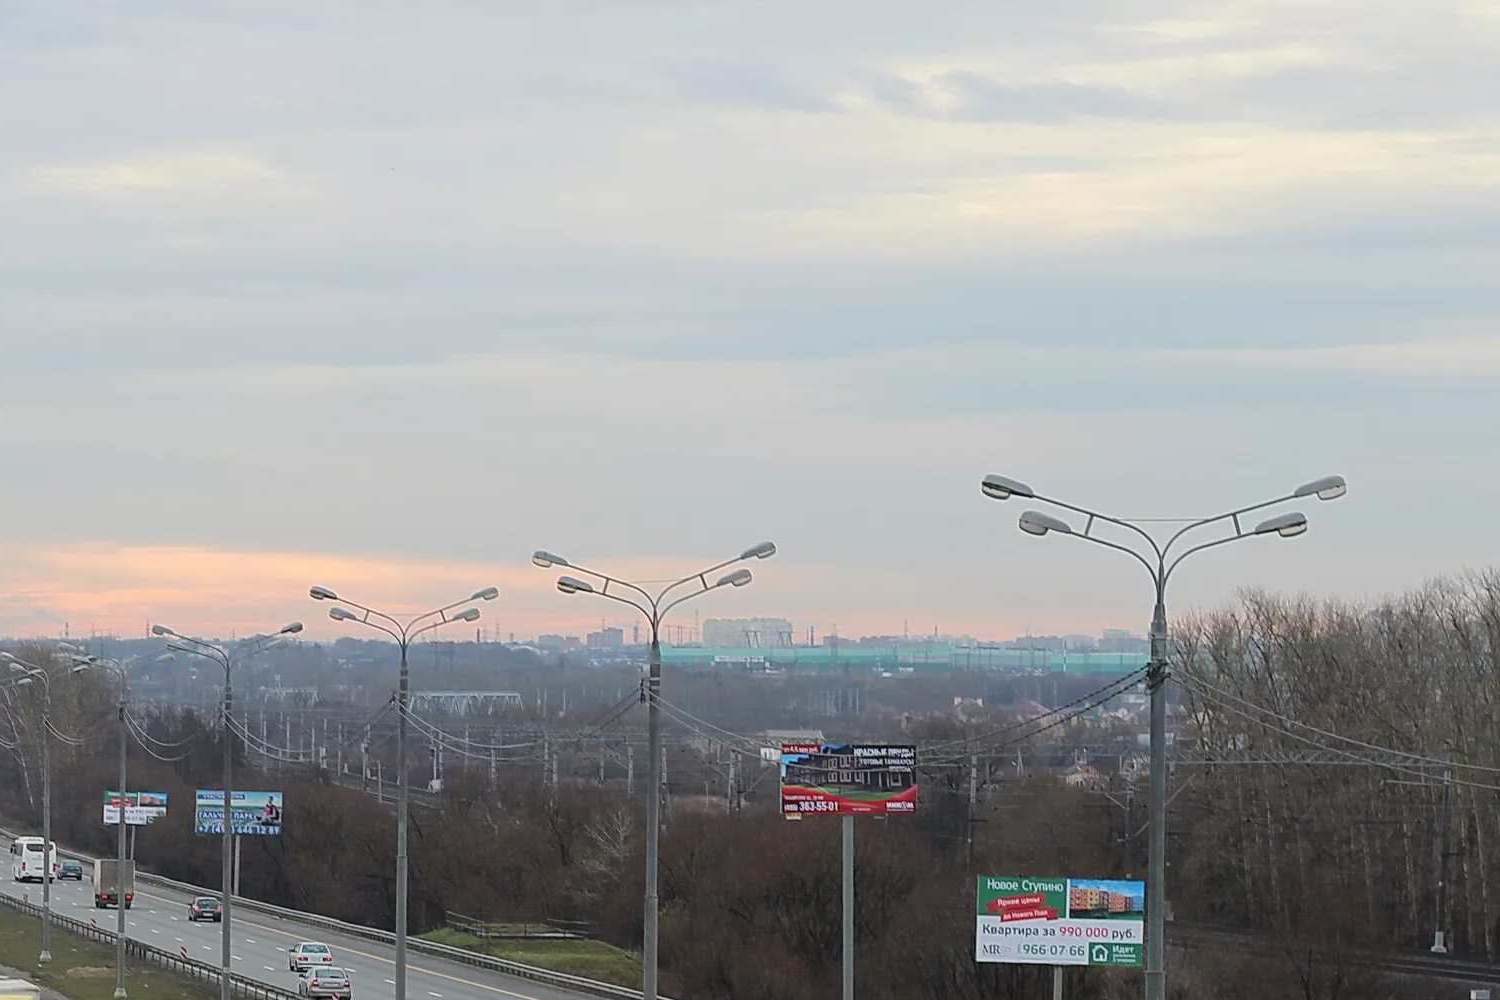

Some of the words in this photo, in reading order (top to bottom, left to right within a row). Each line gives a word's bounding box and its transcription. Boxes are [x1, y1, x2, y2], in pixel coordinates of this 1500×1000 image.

[799, 801, 839, 812] 363-55-01
[987, 878, 1019, 890] Новое
[1021, 879, 1064, 893] Ступино
[982, 924, 1039, 938] Квартира
[1042, 927, 1056, 936] за
[1059, 926, 1083, 938] 990
[1085, 927, 1109, 938] 000
[1111, 928, 1136, 941] руб.
[1112, 944, 1135, 954] Идет
